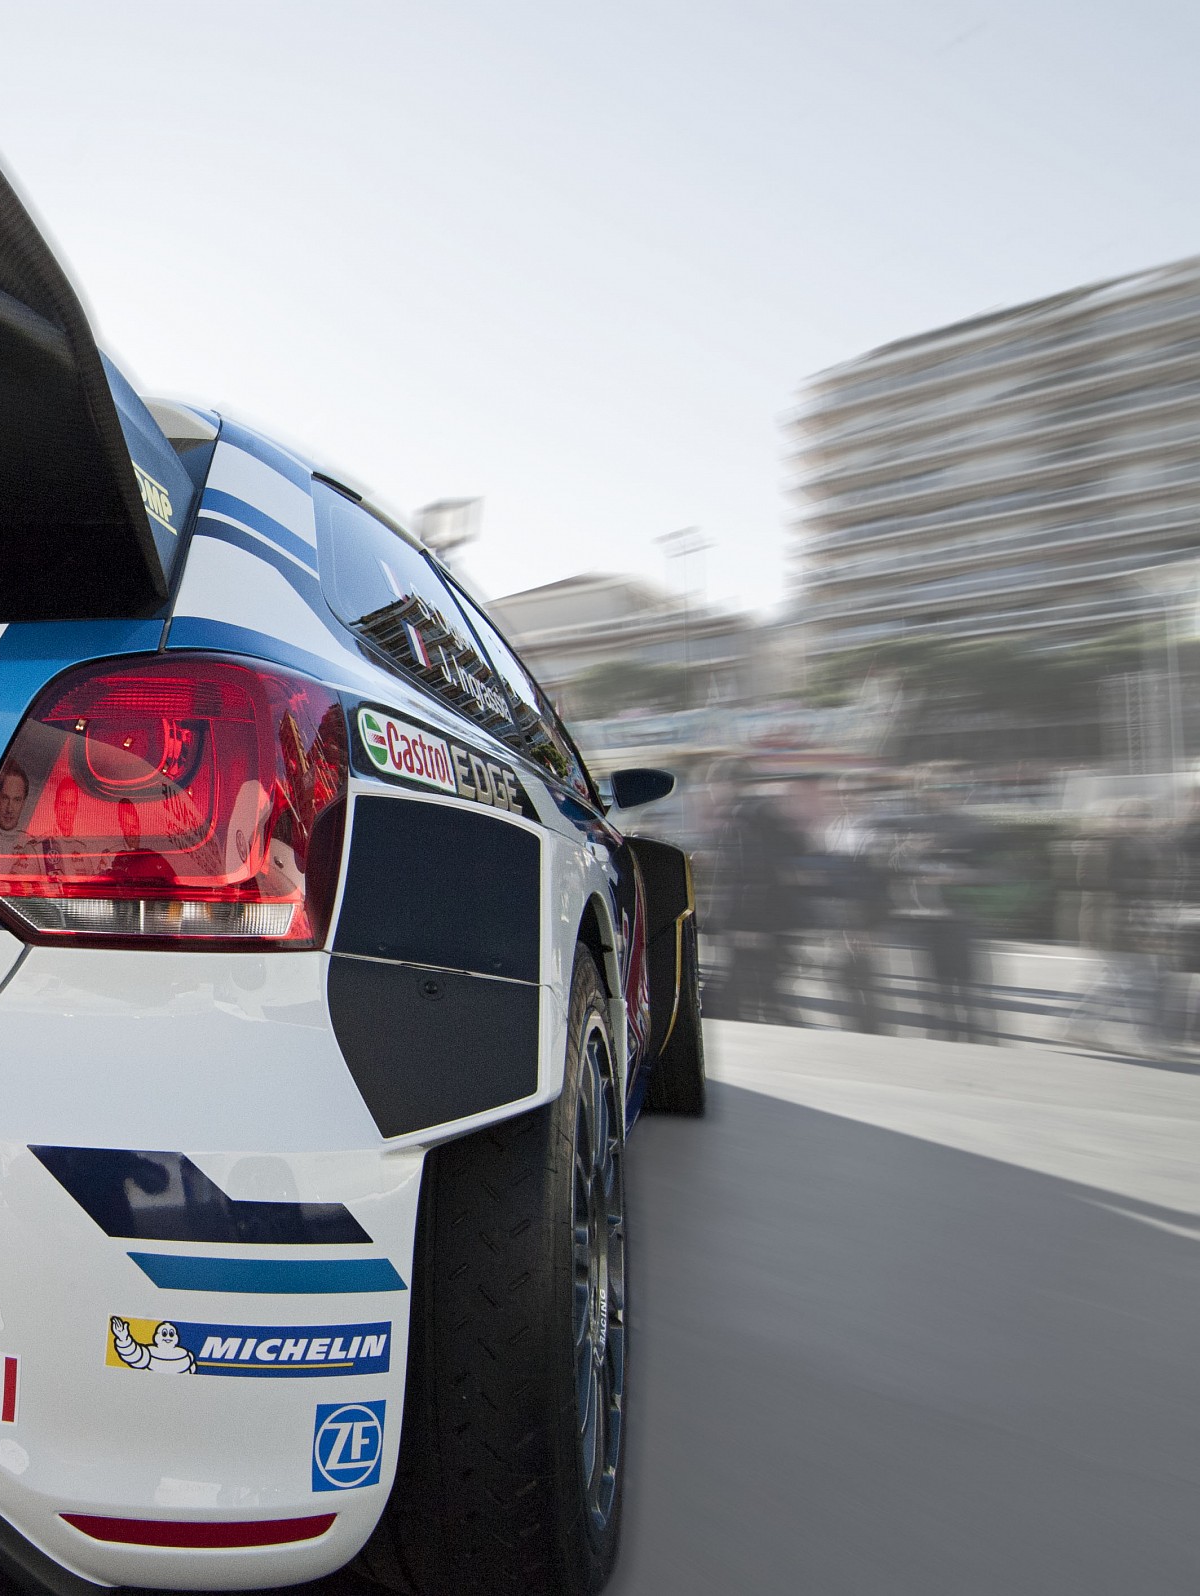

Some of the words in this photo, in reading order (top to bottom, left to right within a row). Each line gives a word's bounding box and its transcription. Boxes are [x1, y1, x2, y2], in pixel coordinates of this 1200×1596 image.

[386, 721, 454, 787] Castrol
[451, 744, 524, 816] EDGE
[599, 1288, 608, 1346] RACING
[198, 1333, 388, 1362] MICHELIN
[321, 1417, 380, 1472] ZF
